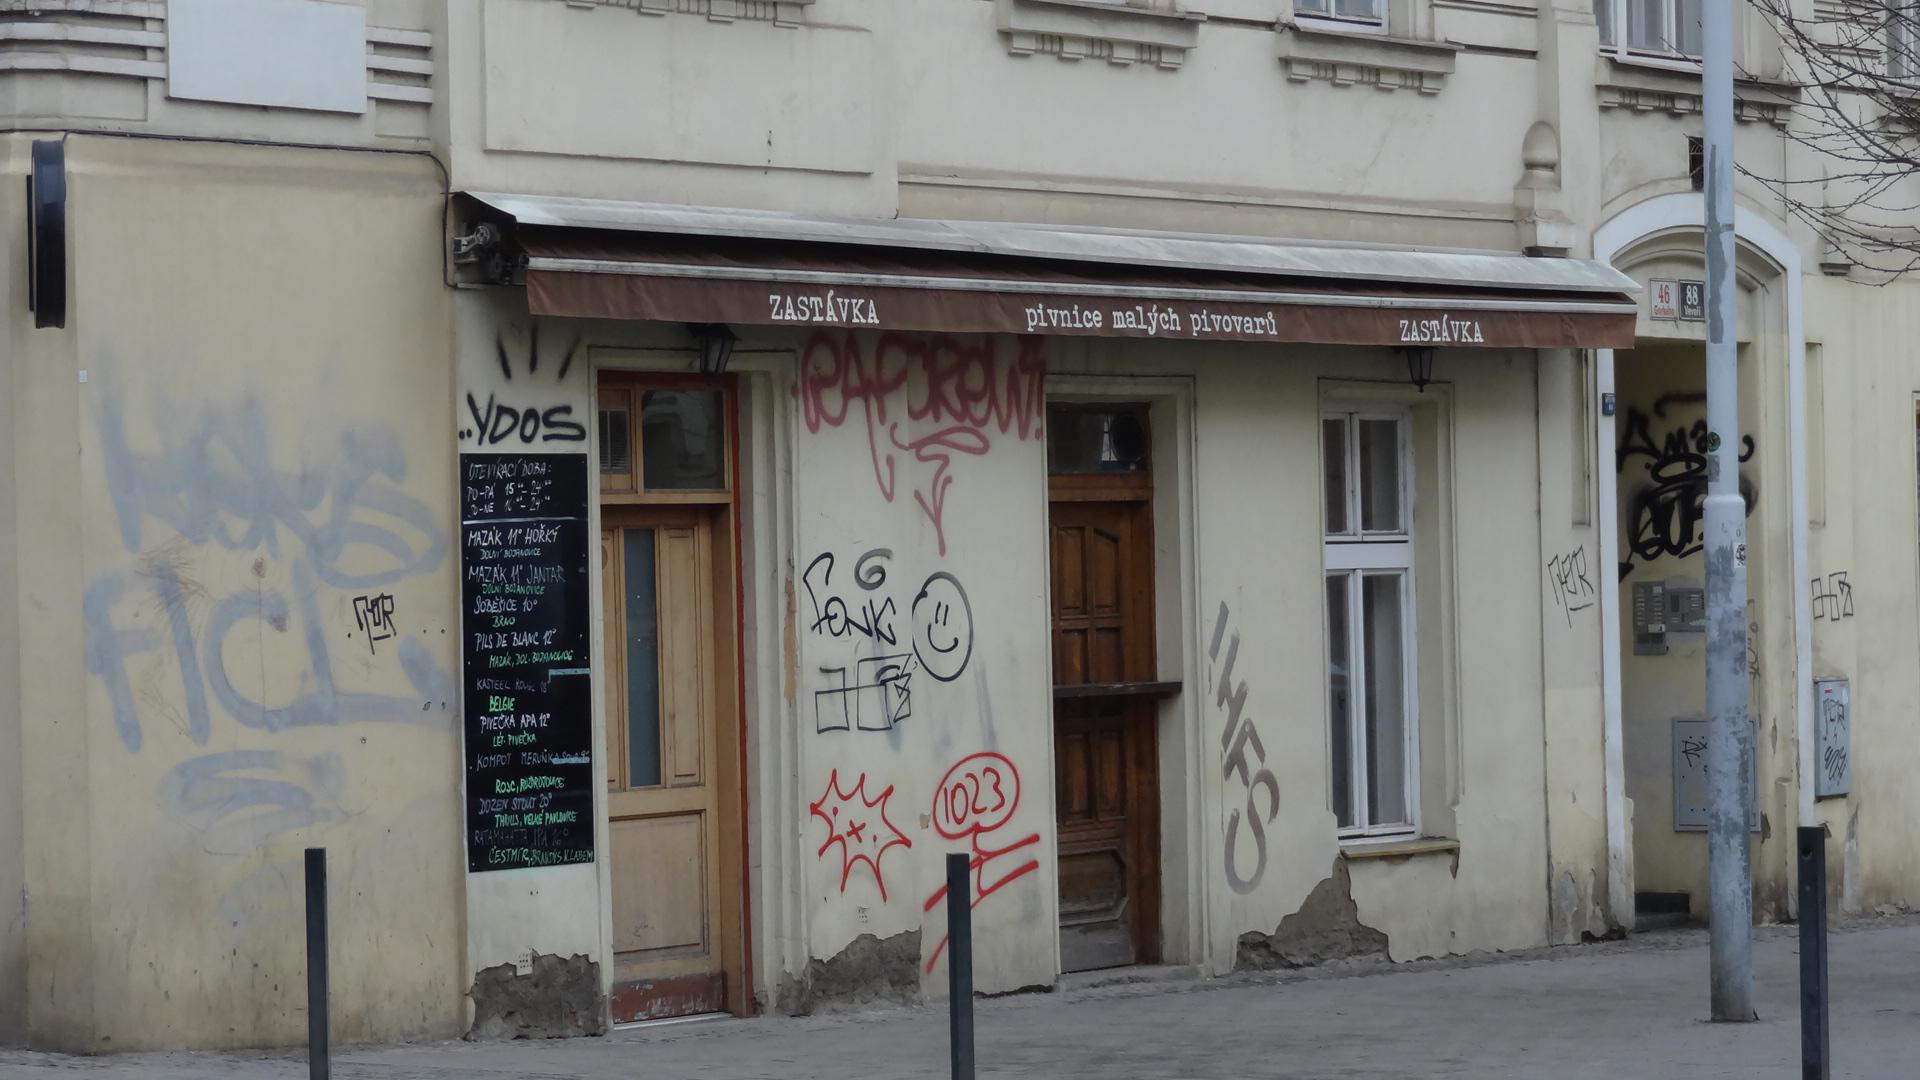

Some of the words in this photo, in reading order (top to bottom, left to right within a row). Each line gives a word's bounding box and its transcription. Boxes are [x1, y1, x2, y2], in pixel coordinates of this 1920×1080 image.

[1658, 284, 1670, 304] 46
[1686, 285, 1699, 305] 88
[769, 289, 880, 324] ZASTÁVKA
[1024, 303, 1103, 332] pivnice
[1112, 304, 1181, 336] malých
[1190, 309, 1278, 337] pivovarů
[1400, 313, 1484, 342] ZASTÁVKA
[496, 632, 508, 647] DE
[520, 713, 537, 729] APA
[943, 766, 1006, 825] 1023
